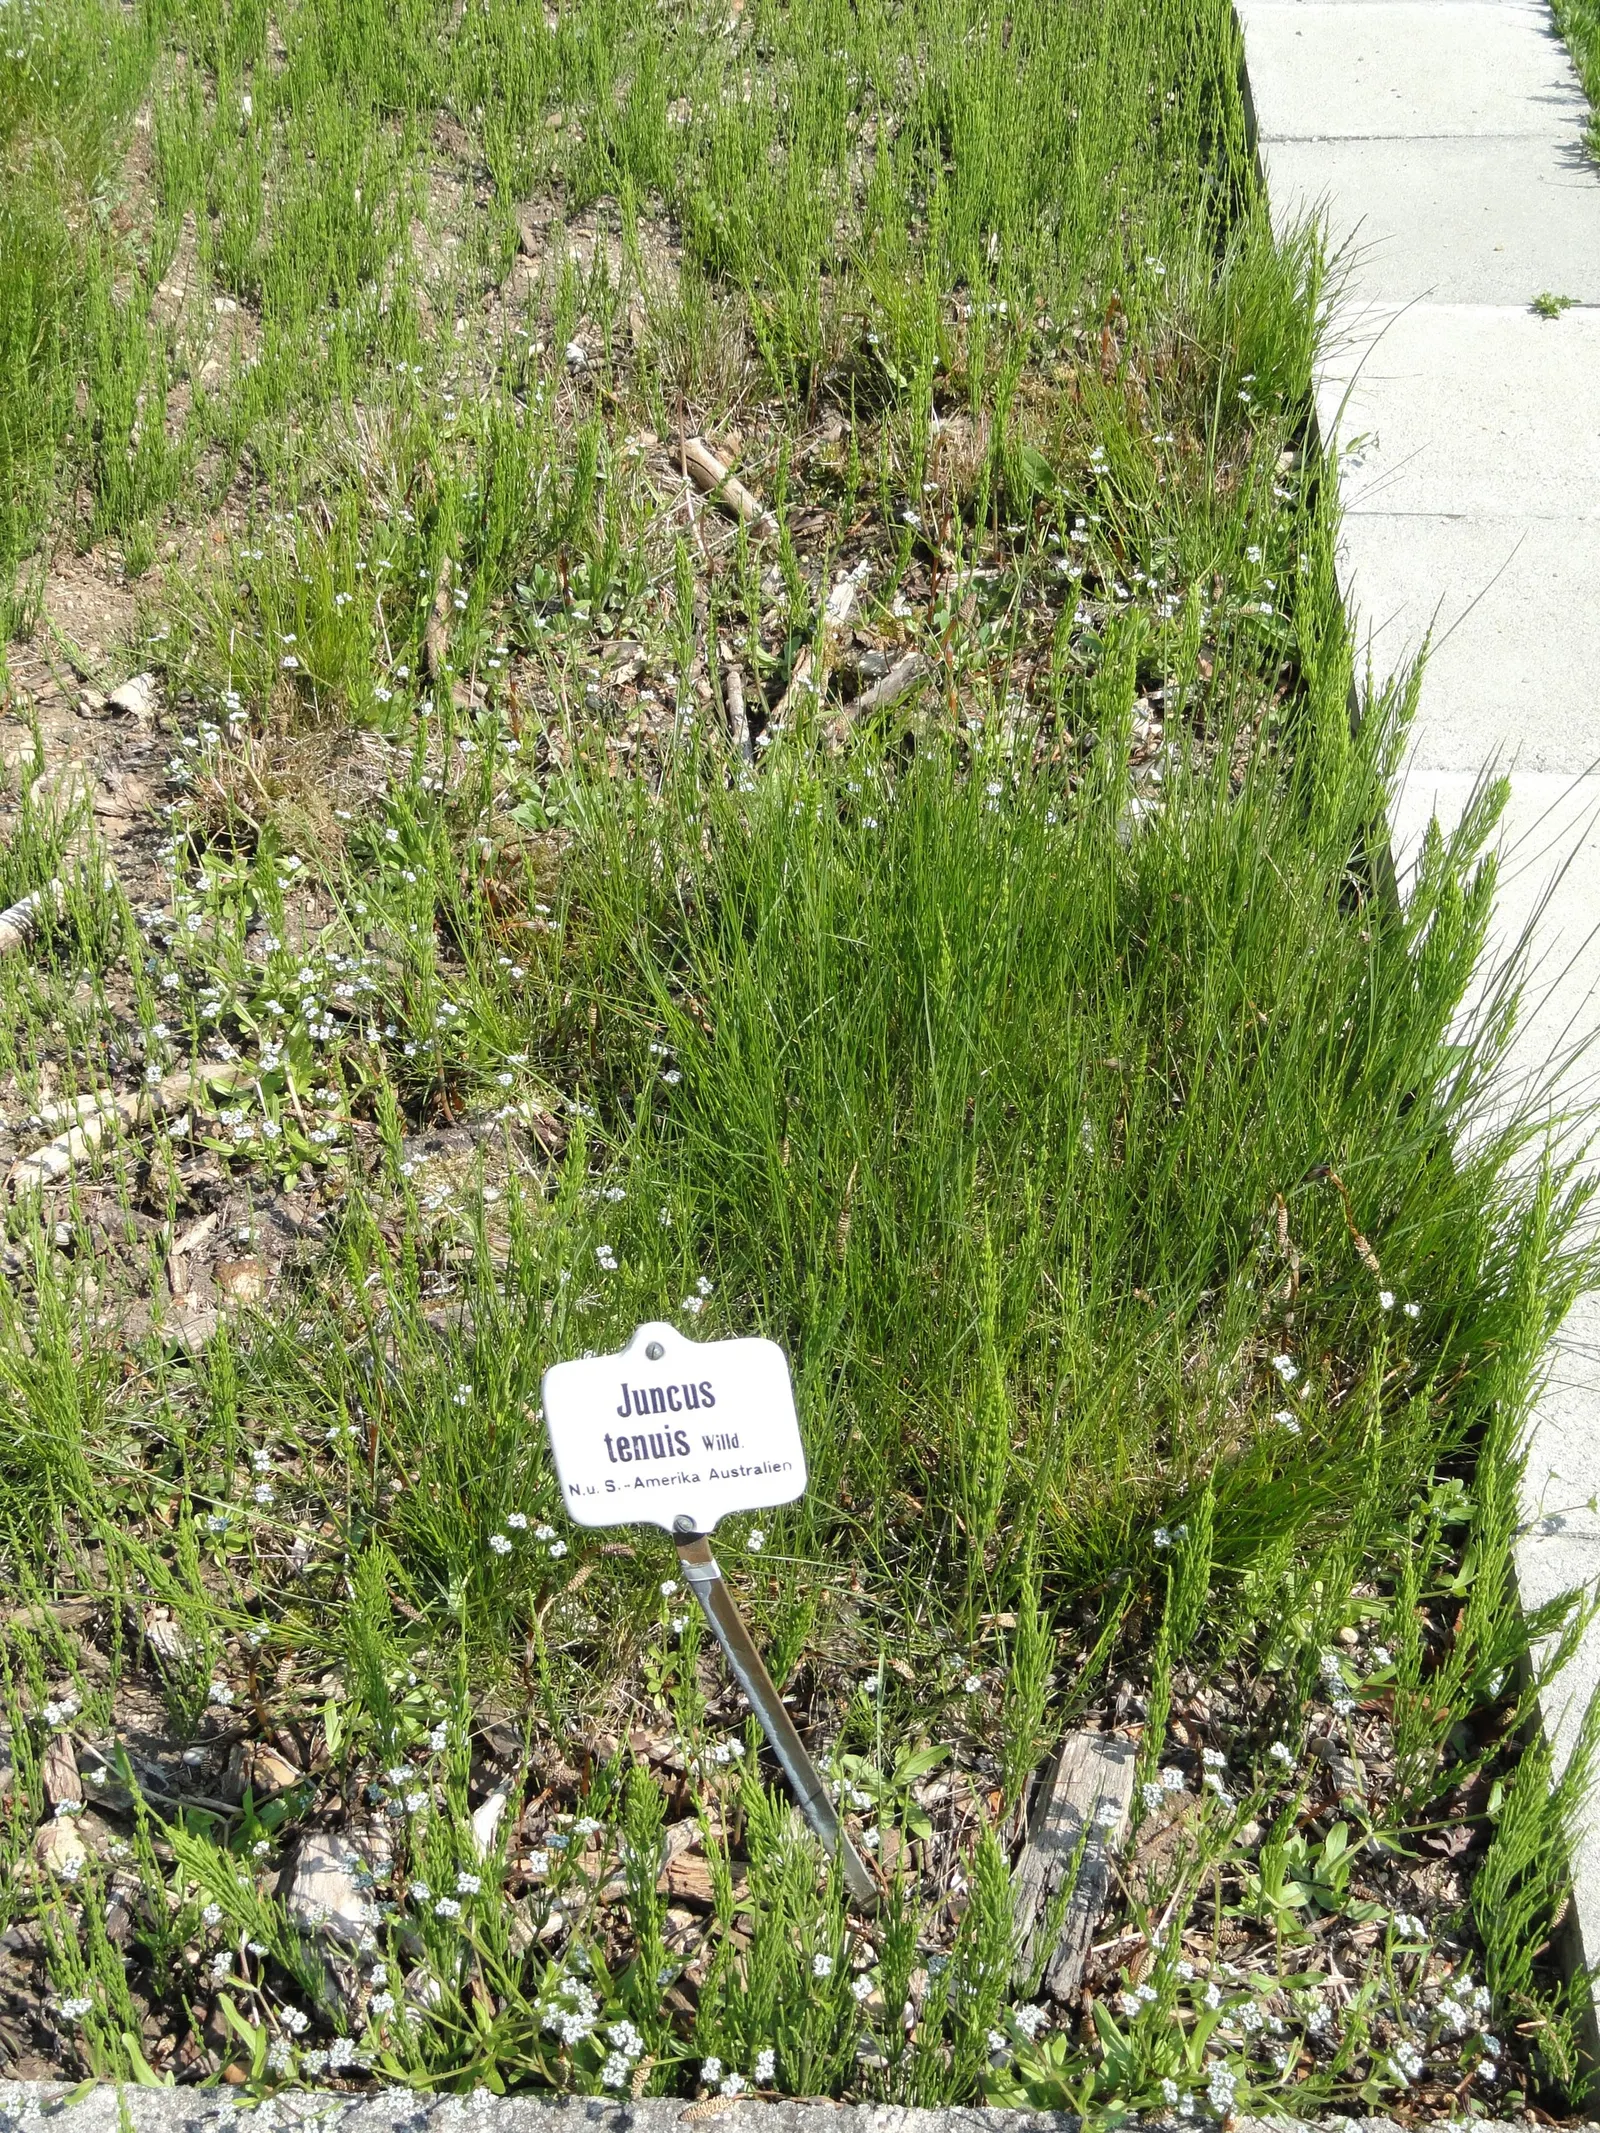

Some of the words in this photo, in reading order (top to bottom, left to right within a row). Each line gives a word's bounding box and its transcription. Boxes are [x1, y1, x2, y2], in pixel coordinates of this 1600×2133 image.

[616, 1380, 716, 1418] Juncus
[603, 1424, 691, 1464] tenuis
[701, 1433, 745, 1451] Willd.
[709, 1460, 792, 1481] Australien
